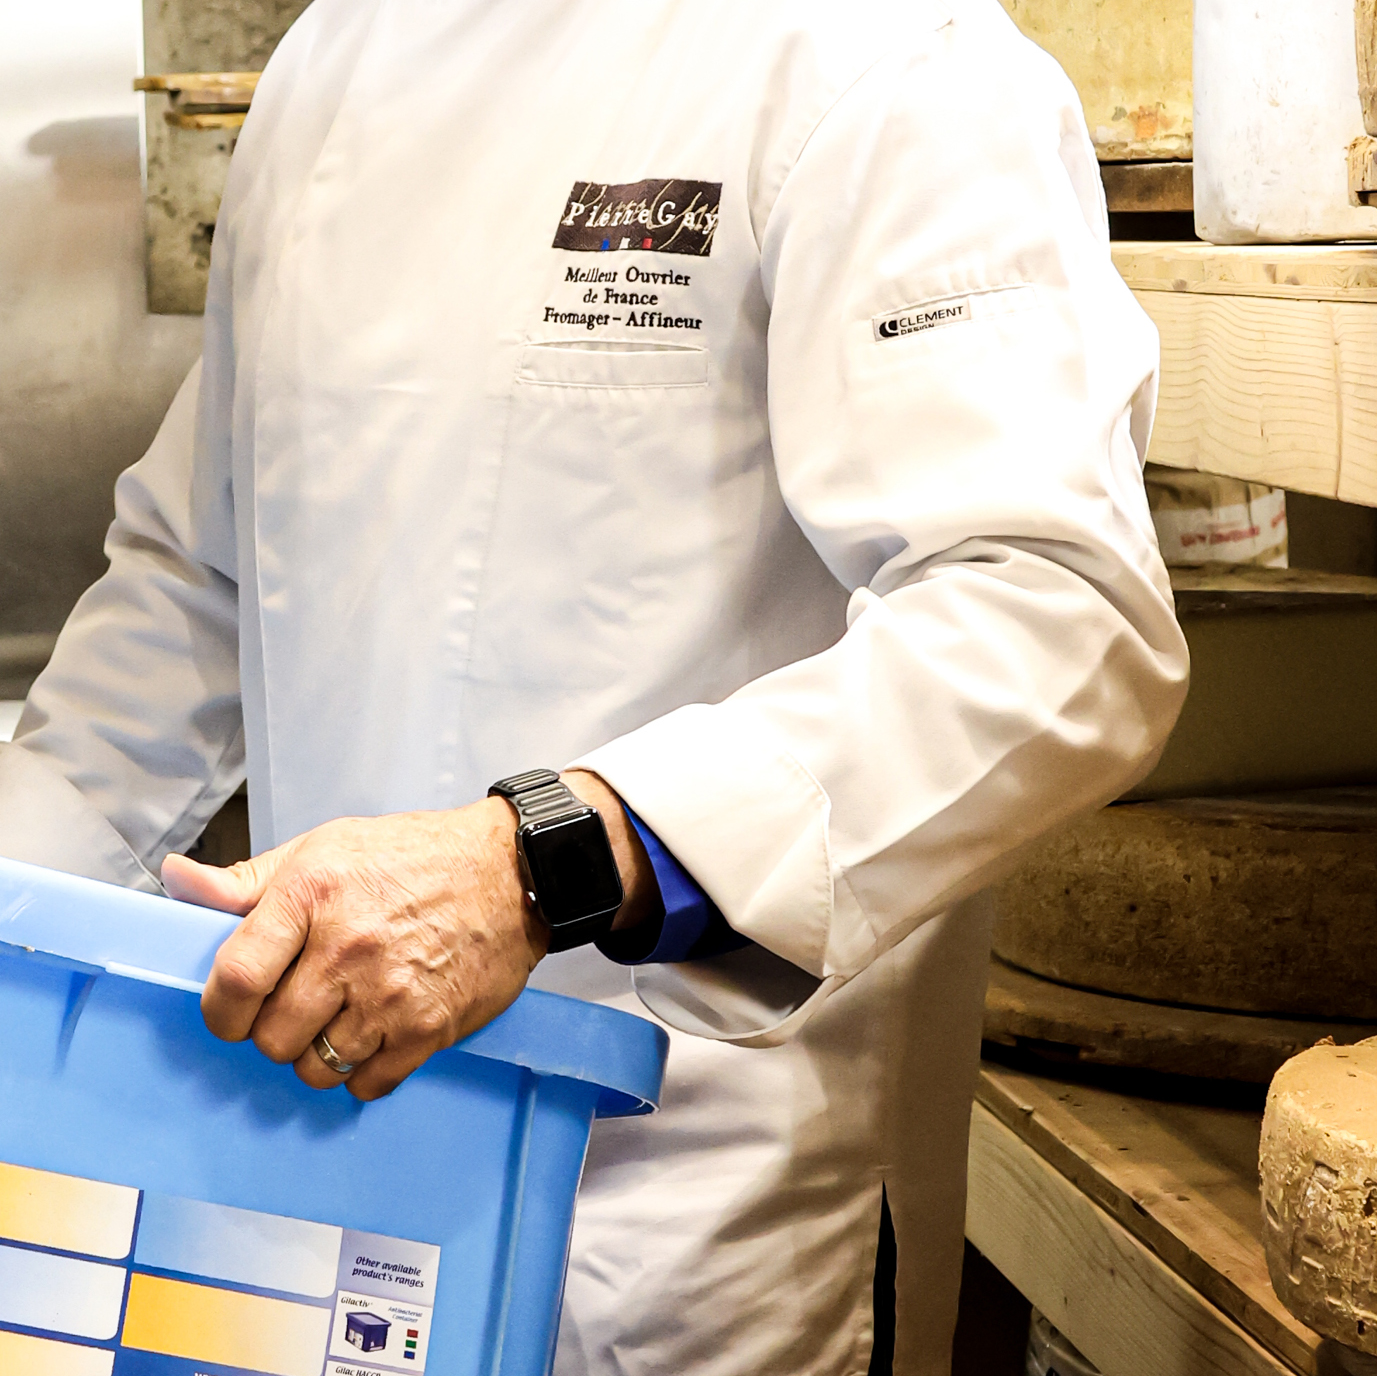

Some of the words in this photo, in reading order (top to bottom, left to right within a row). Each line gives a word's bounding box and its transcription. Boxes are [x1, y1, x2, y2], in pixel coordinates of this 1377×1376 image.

[564, 266, 618, 283] Meilleur
[625, 266, 691, 286] Ouvrier
[583, 288, 598, 304] de
[603, 288, 659, 306] France
[542, 307, 610, 330] Fromager
[625, 311, 703, 330] Affineur
[899, 306, 963, 328] CLEMENT
[355, 1256, 380, 1268] Other
[381, 1263, 422, 1276] available
[351, 1267, 393, 1281] product's
[394, 1276, 424, 1288] ranges
[335, 1365, 355, 1376] Gilac
